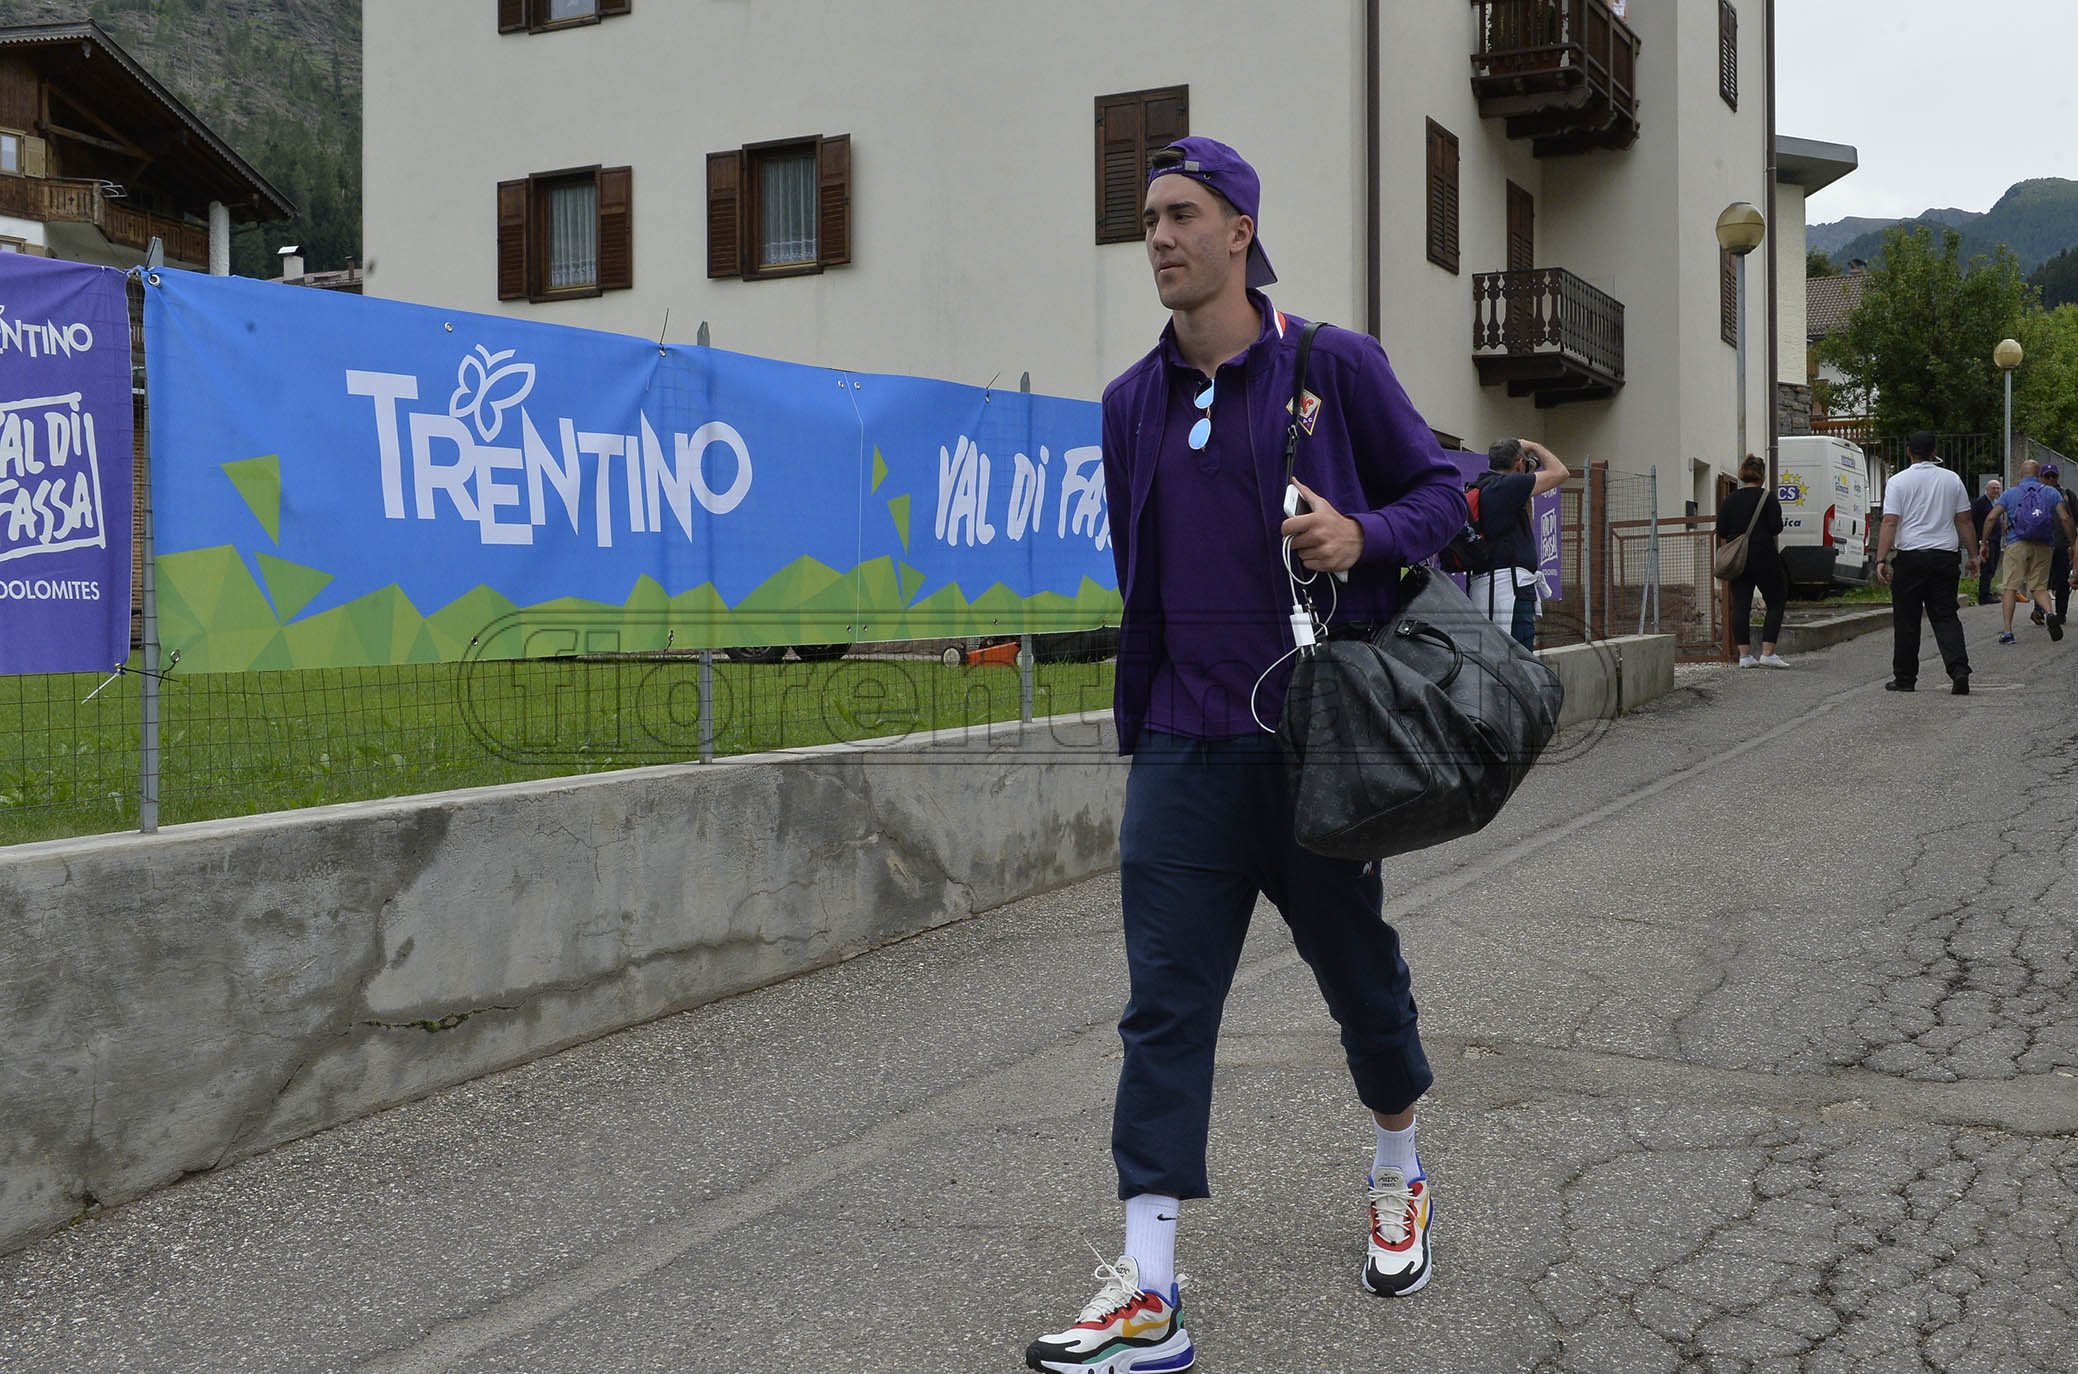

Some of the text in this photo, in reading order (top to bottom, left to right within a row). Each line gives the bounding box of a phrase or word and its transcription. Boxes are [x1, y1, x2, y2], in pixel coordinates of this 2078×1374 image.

[0, 317, 93, 359] NTINO
[0, 411, 45, 478] AL
[346, 369, 752, 547] TRENTINO
[935, 434, 996, 547] VAL
[1783, 517, 1801, 527] ica
